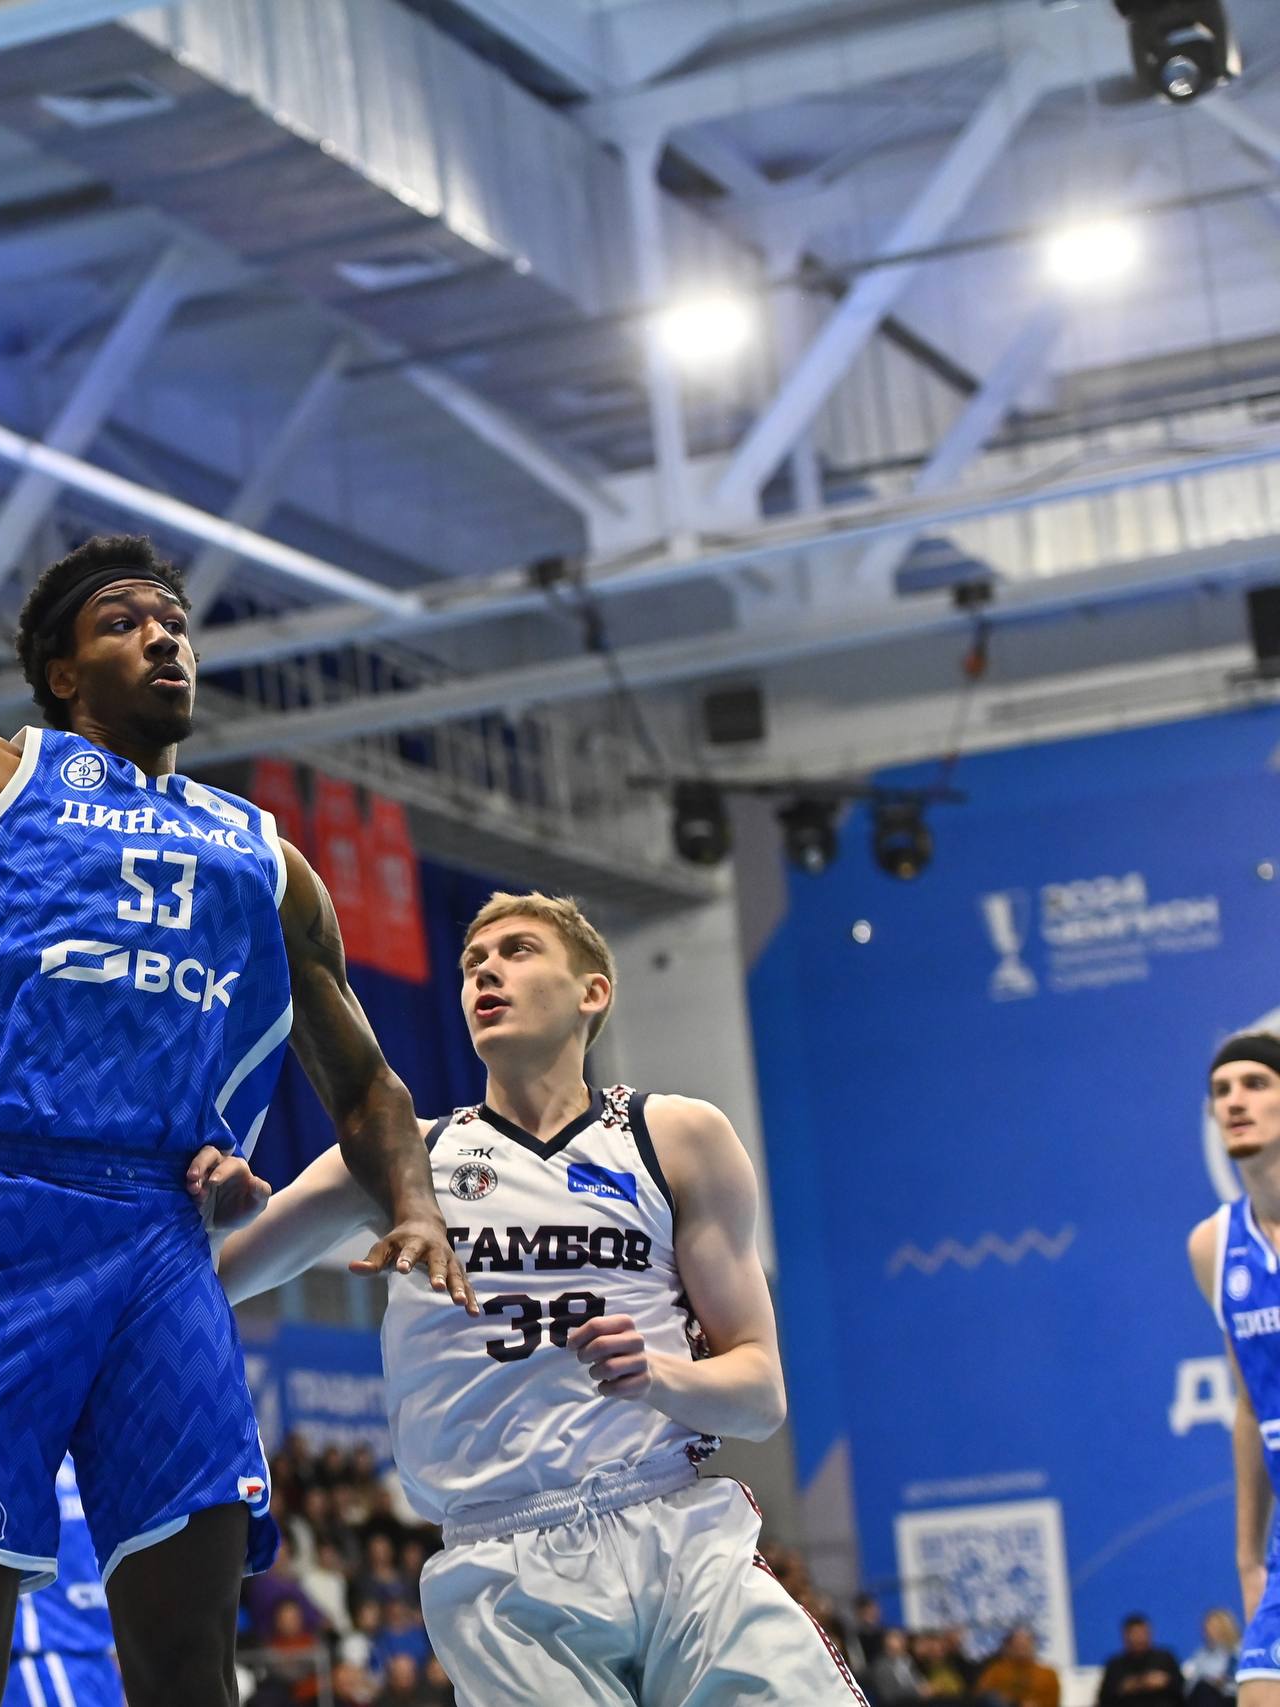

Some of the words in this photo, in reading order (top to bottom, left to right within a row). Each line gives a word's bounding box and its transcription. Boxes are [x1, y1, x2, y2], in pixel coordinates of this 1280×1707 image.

[117, 847, 198, 930] 53
[134, 950, 240, 1013] ВСК
[483, 1291, 606, 1363] 38
